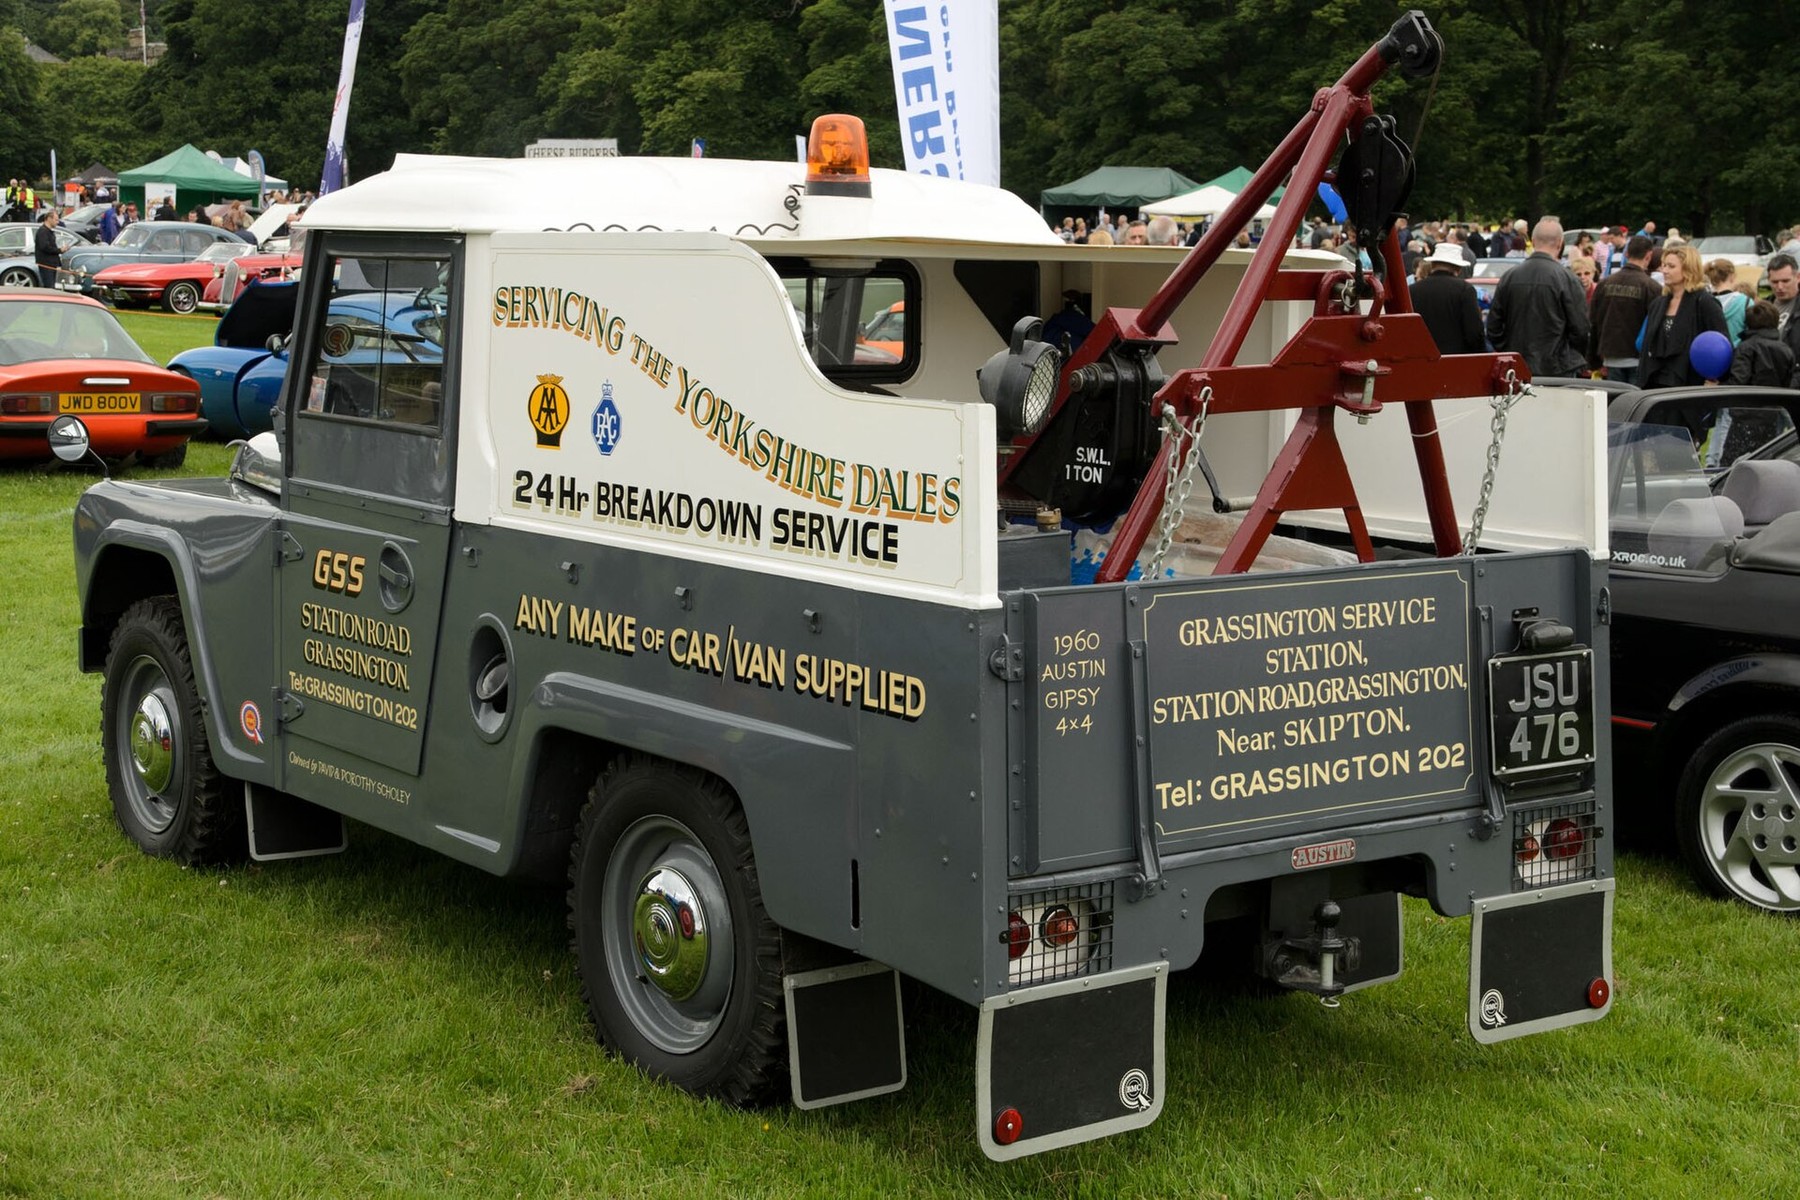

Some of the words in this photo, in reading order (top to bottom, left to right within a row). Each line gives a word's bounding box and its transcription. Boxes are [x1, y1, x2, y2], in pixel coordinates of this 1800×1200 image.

[568, 147, 616, 158] BURGERS
[62, 395, 94, 410] JWD
[97, 395, 139, 410] 800V
[492, 285, 627, 356] SERVICING
[629, 331, 674, 390] THE
[674, 364, 847, 509] YORKSHIRE
[848, 462, 961, 525] DALES
[595, 406, 618, 446] RAC
[1065, 464, 1071, 480] 1
[1073, 464, 1103, 485] TON
[1075, 446, 1112, 467] S.W.L.
[597, 480, 763, 546] BREAKDOWN
[772, 506, 899, 567] SERVICE
[312, 548, 367, 597] GSS
[1612, 550, 1687, 569] XROC.co.uk
[301, 602, 365, 644] STATION
[366, 617, 413, 657] ROAD,
[1053, 629, 1100, 656] 1960
[1179, 606, 1336, 647] GRASSINGTON
[1341, 597, 1436, 630] SERVICE
[303, 638, 411, 691] GRASSINGTON.
[514, 594, 564, 638] ANY
[568, 603, 637, 657] MAKE
[670, 624, 786, 688] CAR/VAN
[795, 652, 926, 721] SUPPLIED
[1041, 658, 1106, 682] AUSTIN
[1265, 639, 1369, 675] STATION,
[305, 676, 394, 722] GRASSINGTON
[395, 702, 418, 730] 202
[1045, 686, 1101, 710] GIPSY
[1153, 687, 1255, 725] STATION
[1315, 663, 1468, 705] GRASSINGTON,
[1508, 660, 1579, 713] JSU
[1055, 713, 1094, 737] 4x4
[1283, 706, 1412, 748] SKIPTON.
[1509, 711, 1580, 762] 476
[1155, 778, 1202, 810] Tel:
[1210, 749, 1410, 801] GRASSINGTON
[1418, 742, 1466, 772] 202
[1295, 841, 1353, 867] AUSTIN
